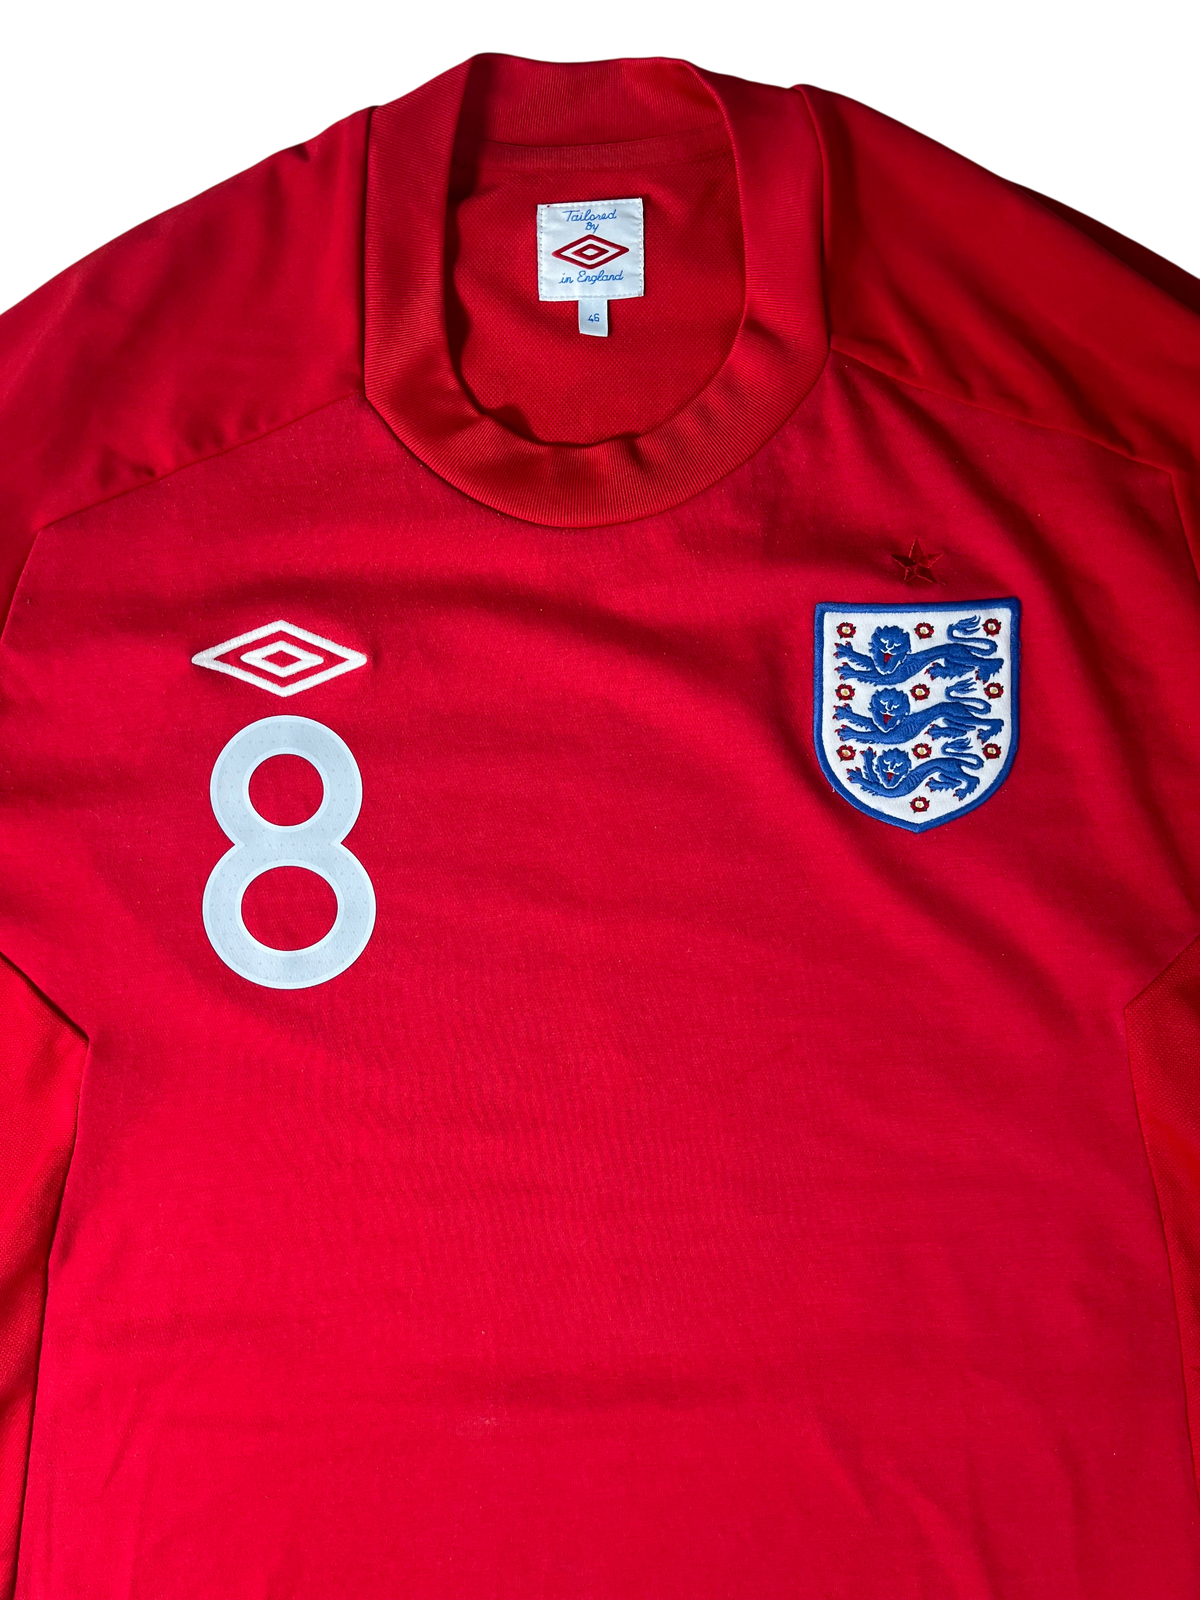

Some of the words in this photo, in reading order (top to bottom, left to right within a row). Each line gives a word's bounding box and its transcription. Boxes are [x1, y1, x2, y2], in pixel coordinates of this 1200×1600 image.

[562, 209, 617, 222] Tailored
[585, 222, 599, 234] By
[559, 273, 574, 284] in
[577, 270, 624, 285] England
[588, 313, 600, 322] 46
[202, 714, 377, 990] 8
